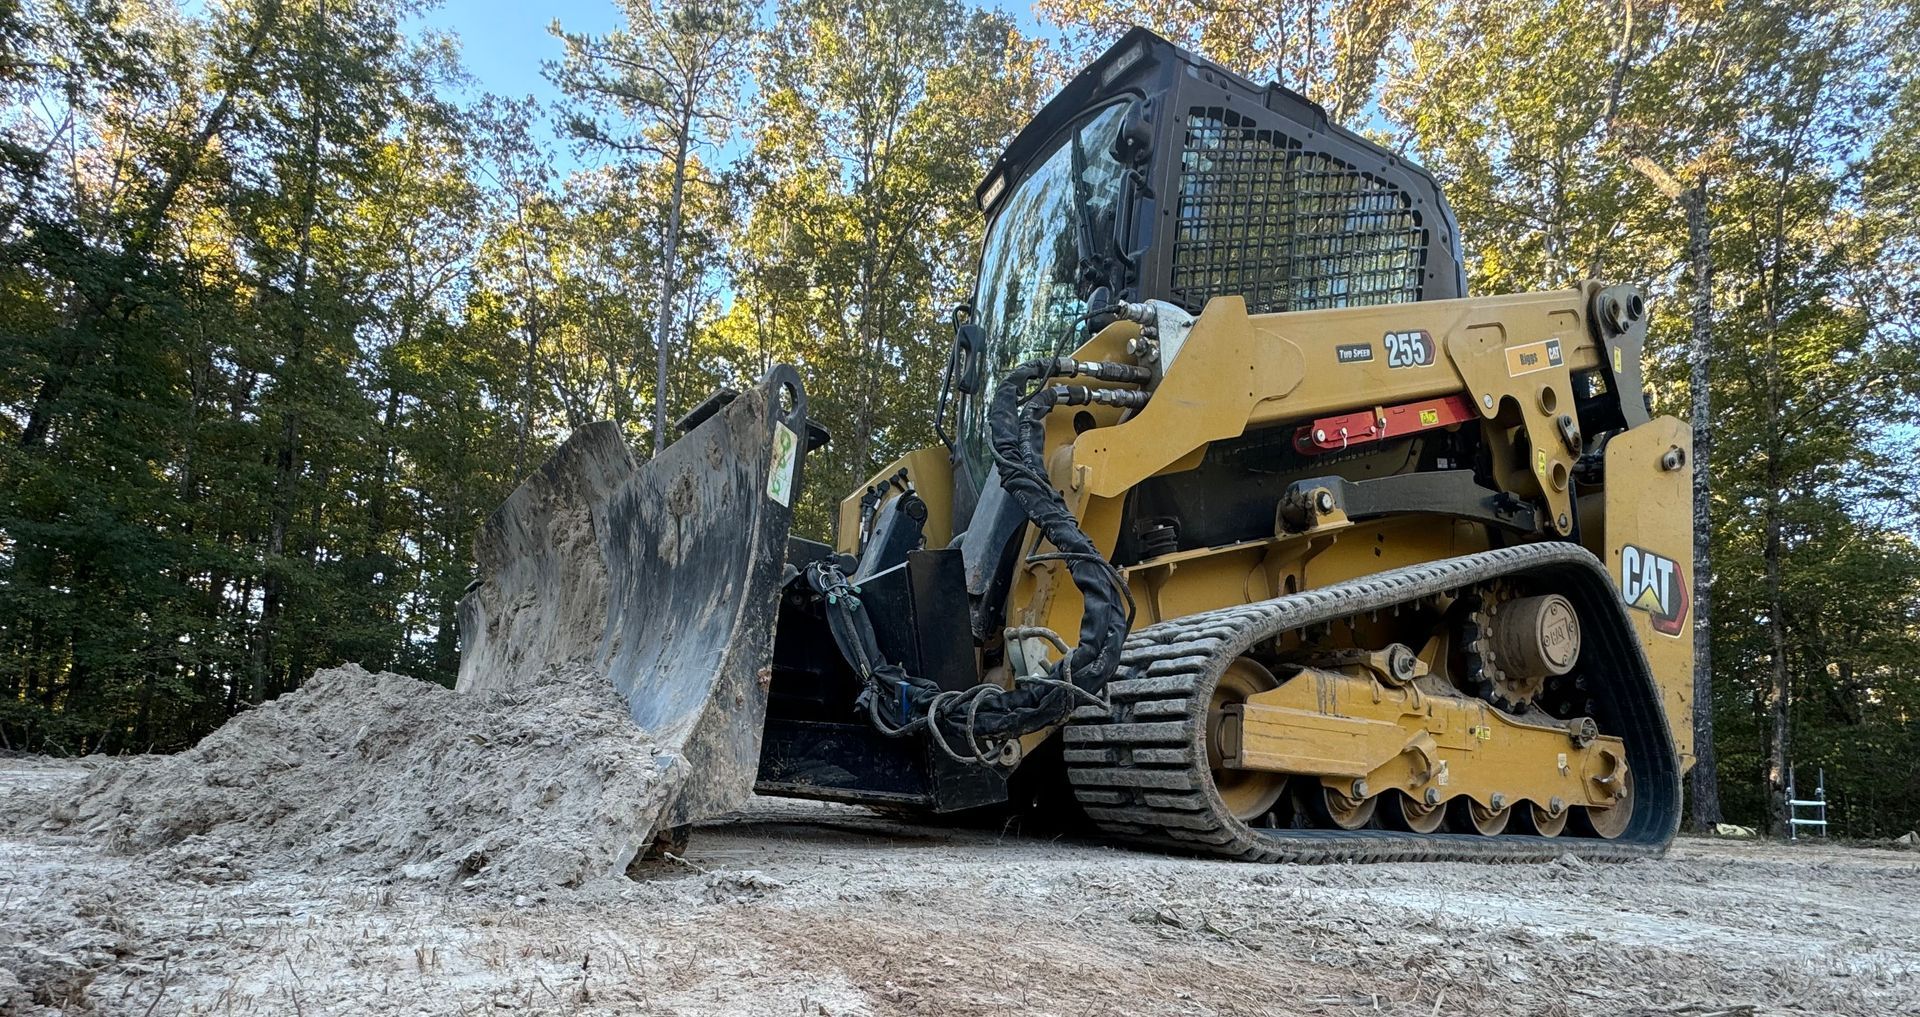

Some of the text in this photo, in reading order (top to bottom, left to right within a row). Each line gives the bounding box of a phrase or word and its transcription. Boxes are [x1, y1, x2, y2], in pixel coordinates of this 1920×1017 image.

[1385, 332, 1426, 366] 255
[1548, 346, 1560, 360] CAT
[1622, 546, 1674, 615] CAT
